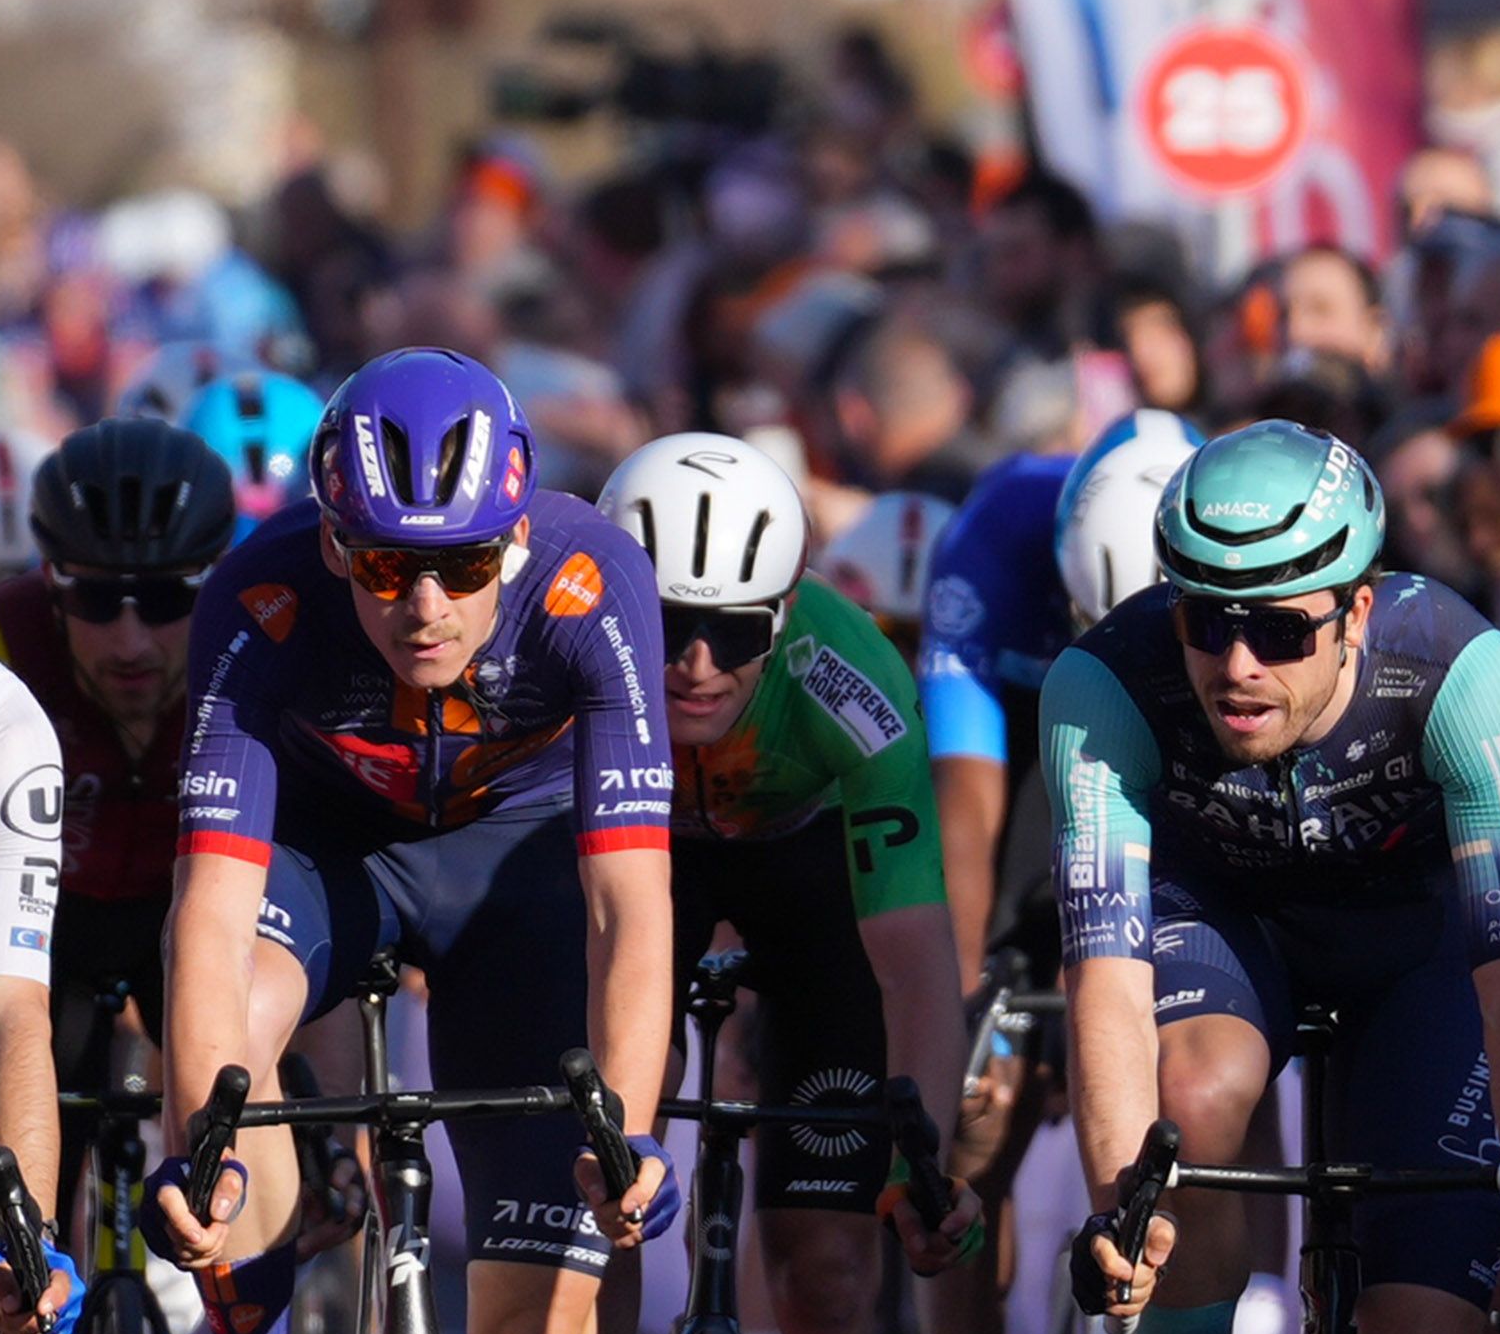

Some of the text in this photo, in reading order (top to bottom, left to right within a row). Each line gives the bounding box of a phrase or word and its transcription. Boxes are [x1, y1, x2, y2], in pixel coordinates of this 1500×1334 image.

[354, 414, 387, 498] LAZER
[461, 409, 492, 500] LAZER
[400, 515, 445, 525] LAZER
[1203, 502, 1270, 519] AMACX
[805, 668, 851, 715] HOME
[815, 650, 904, 741] PREFERENCE
[784, 1179, 859, 1193] MAVIC
[482, 1237, 610, 1265] LAPIERRE
